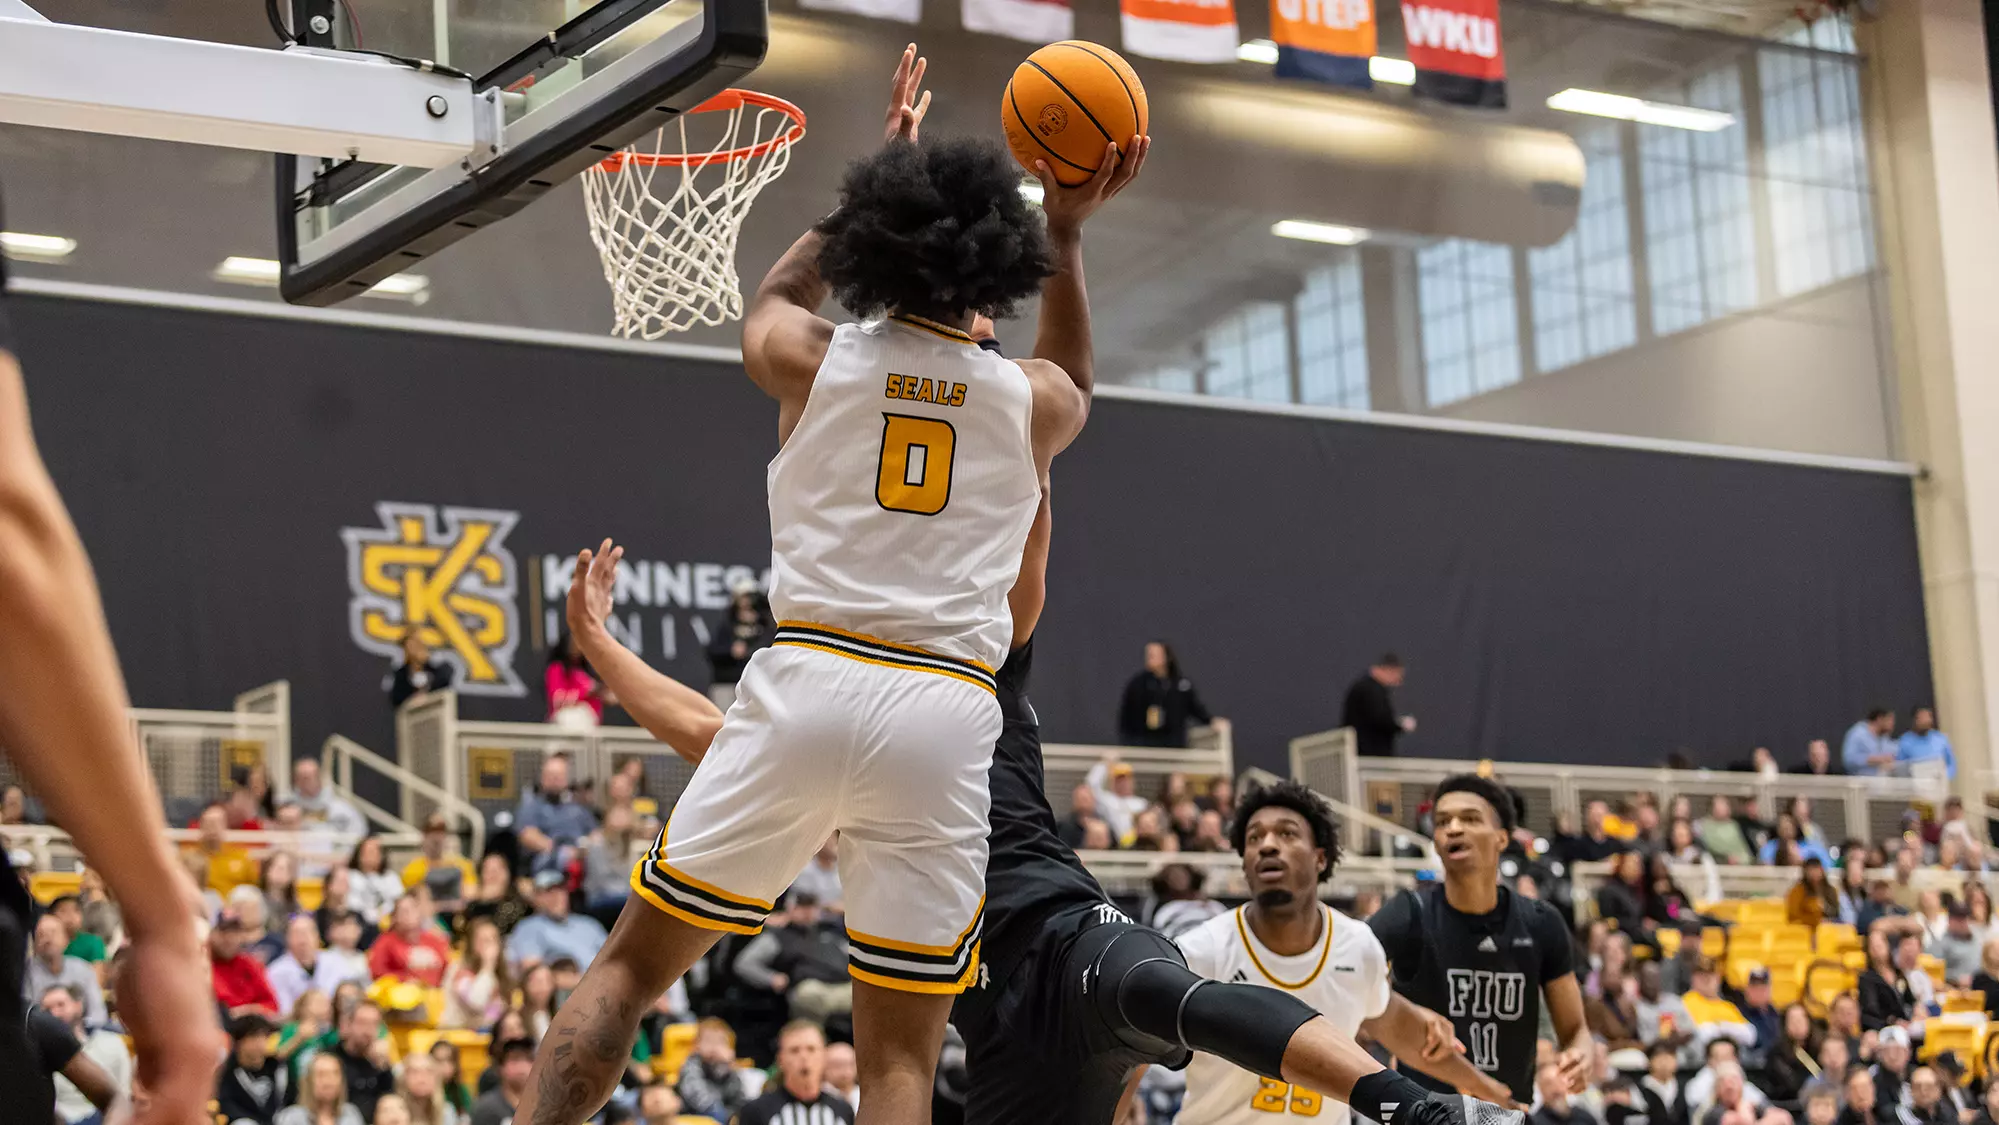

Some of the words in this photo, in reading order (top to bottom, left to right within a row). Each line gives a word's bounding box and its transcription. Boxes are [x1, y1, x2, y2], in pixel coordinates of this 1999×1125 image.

[1402, 3, 1498, 58] WKU
[885, 373, 967, 407] SEALS
[875, 411, 957, 516] 0
[1447, 968, 1526, 1021] FIU
[1469, 1021, 1499, 1071] 11
[1252, 1075, 1323, 1118] 25
